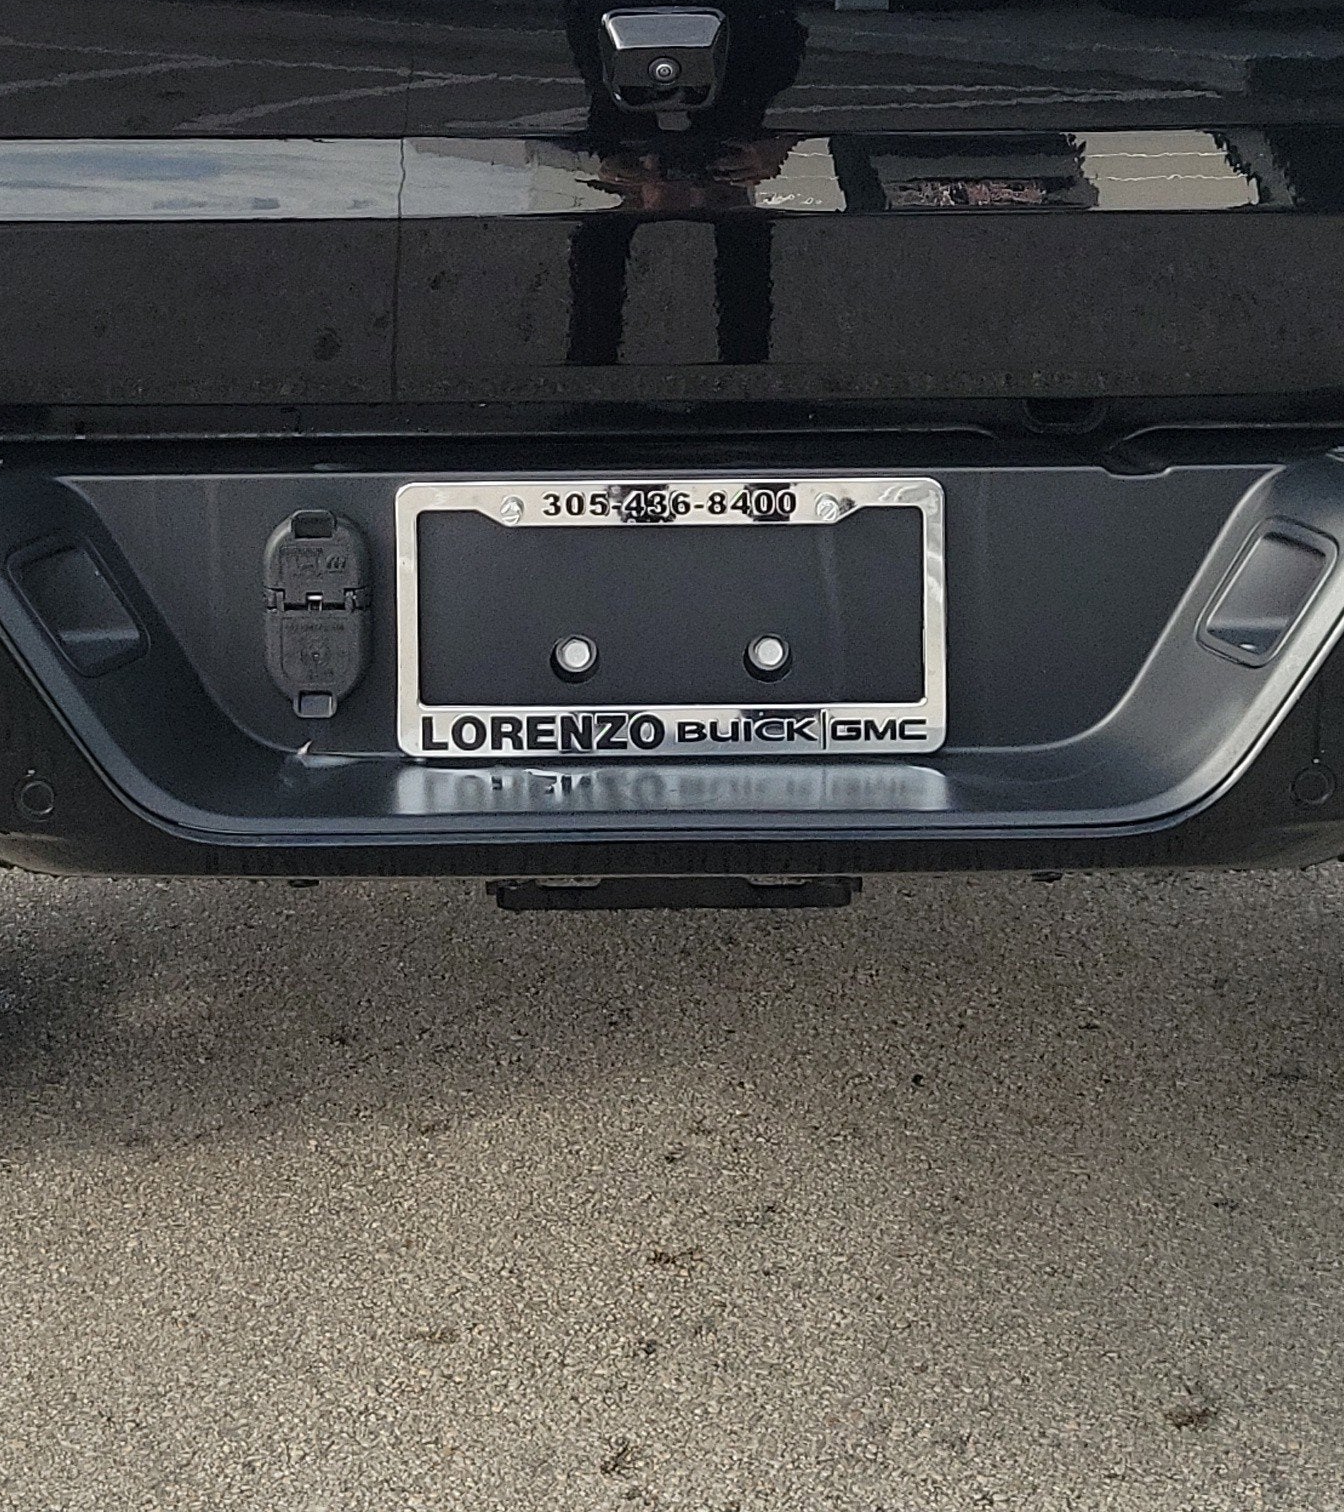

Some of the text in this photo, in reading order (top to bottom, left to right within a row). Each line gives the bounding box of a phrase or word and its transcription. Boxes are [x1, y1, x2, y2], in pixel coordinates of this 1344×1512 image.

[542, 490, 798, 516] 305-436-8400
[420, 713, 928, 751] LORENZO BUICK GMC
